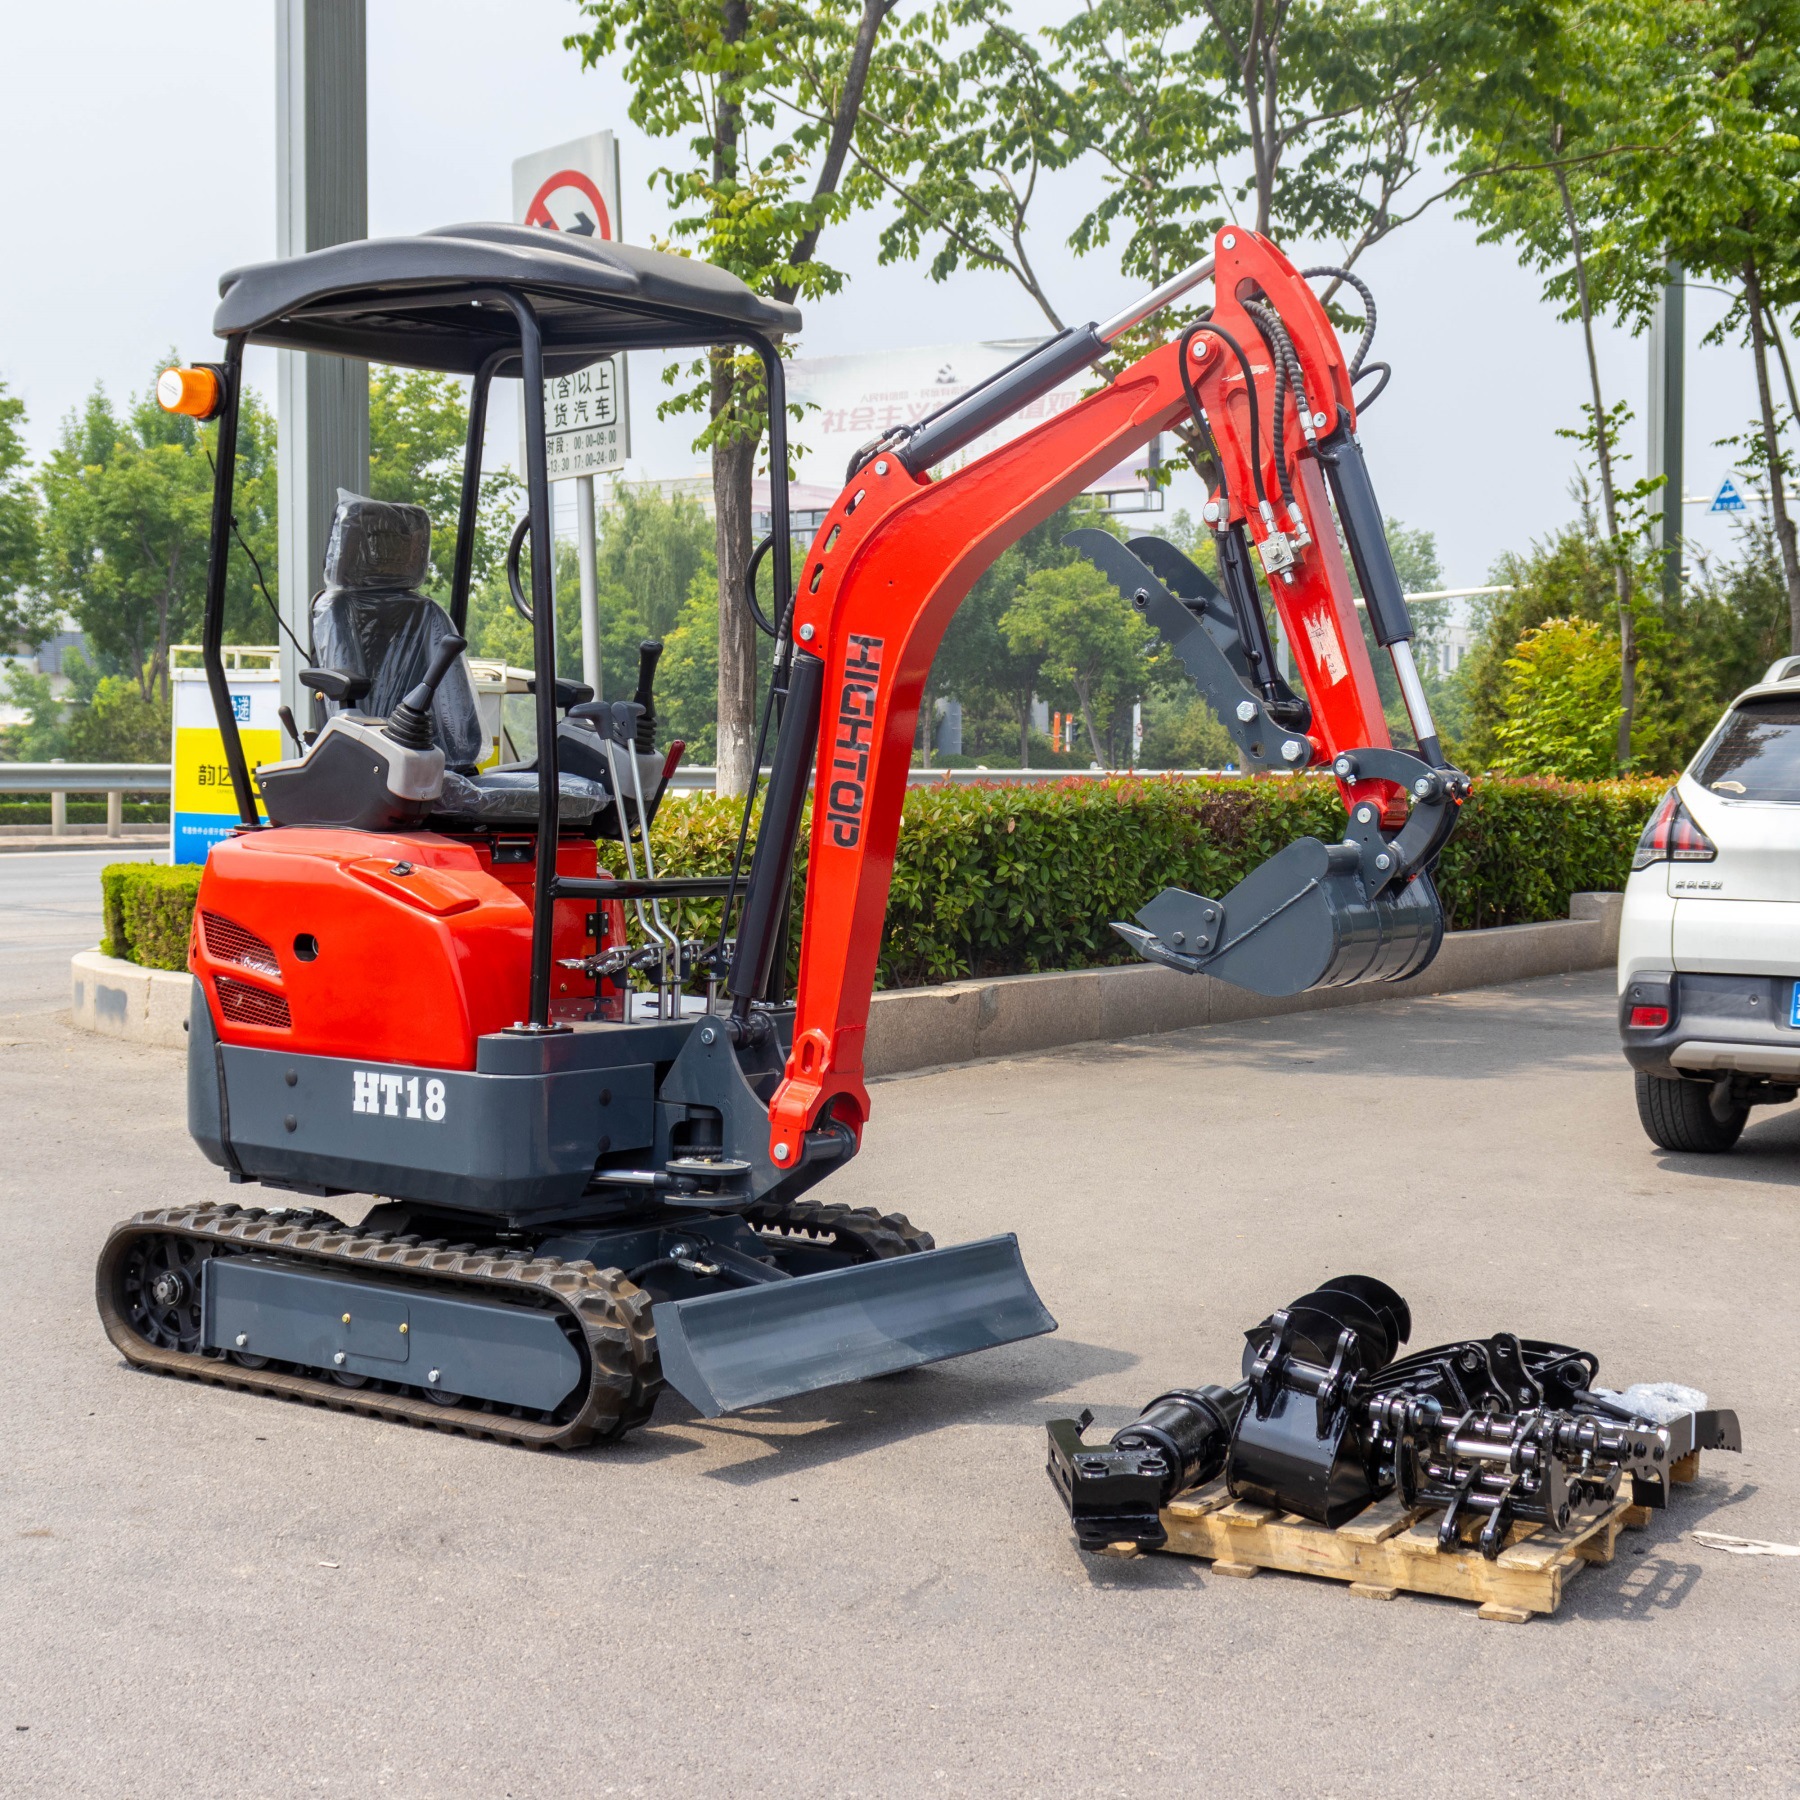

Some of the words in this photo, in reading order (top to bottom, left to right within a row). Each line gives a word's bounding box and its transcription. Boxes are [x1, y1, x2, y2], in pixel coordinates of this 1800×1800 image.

[544, 367, 610, 401] (含)以上
[544, 396, 611, 428] 货汽车
[574, 449, 617, 469] 17:00-24:00
[827, 634, 884, 848] HIGHTOP
[353, 1071, 446, 1121] HT18
